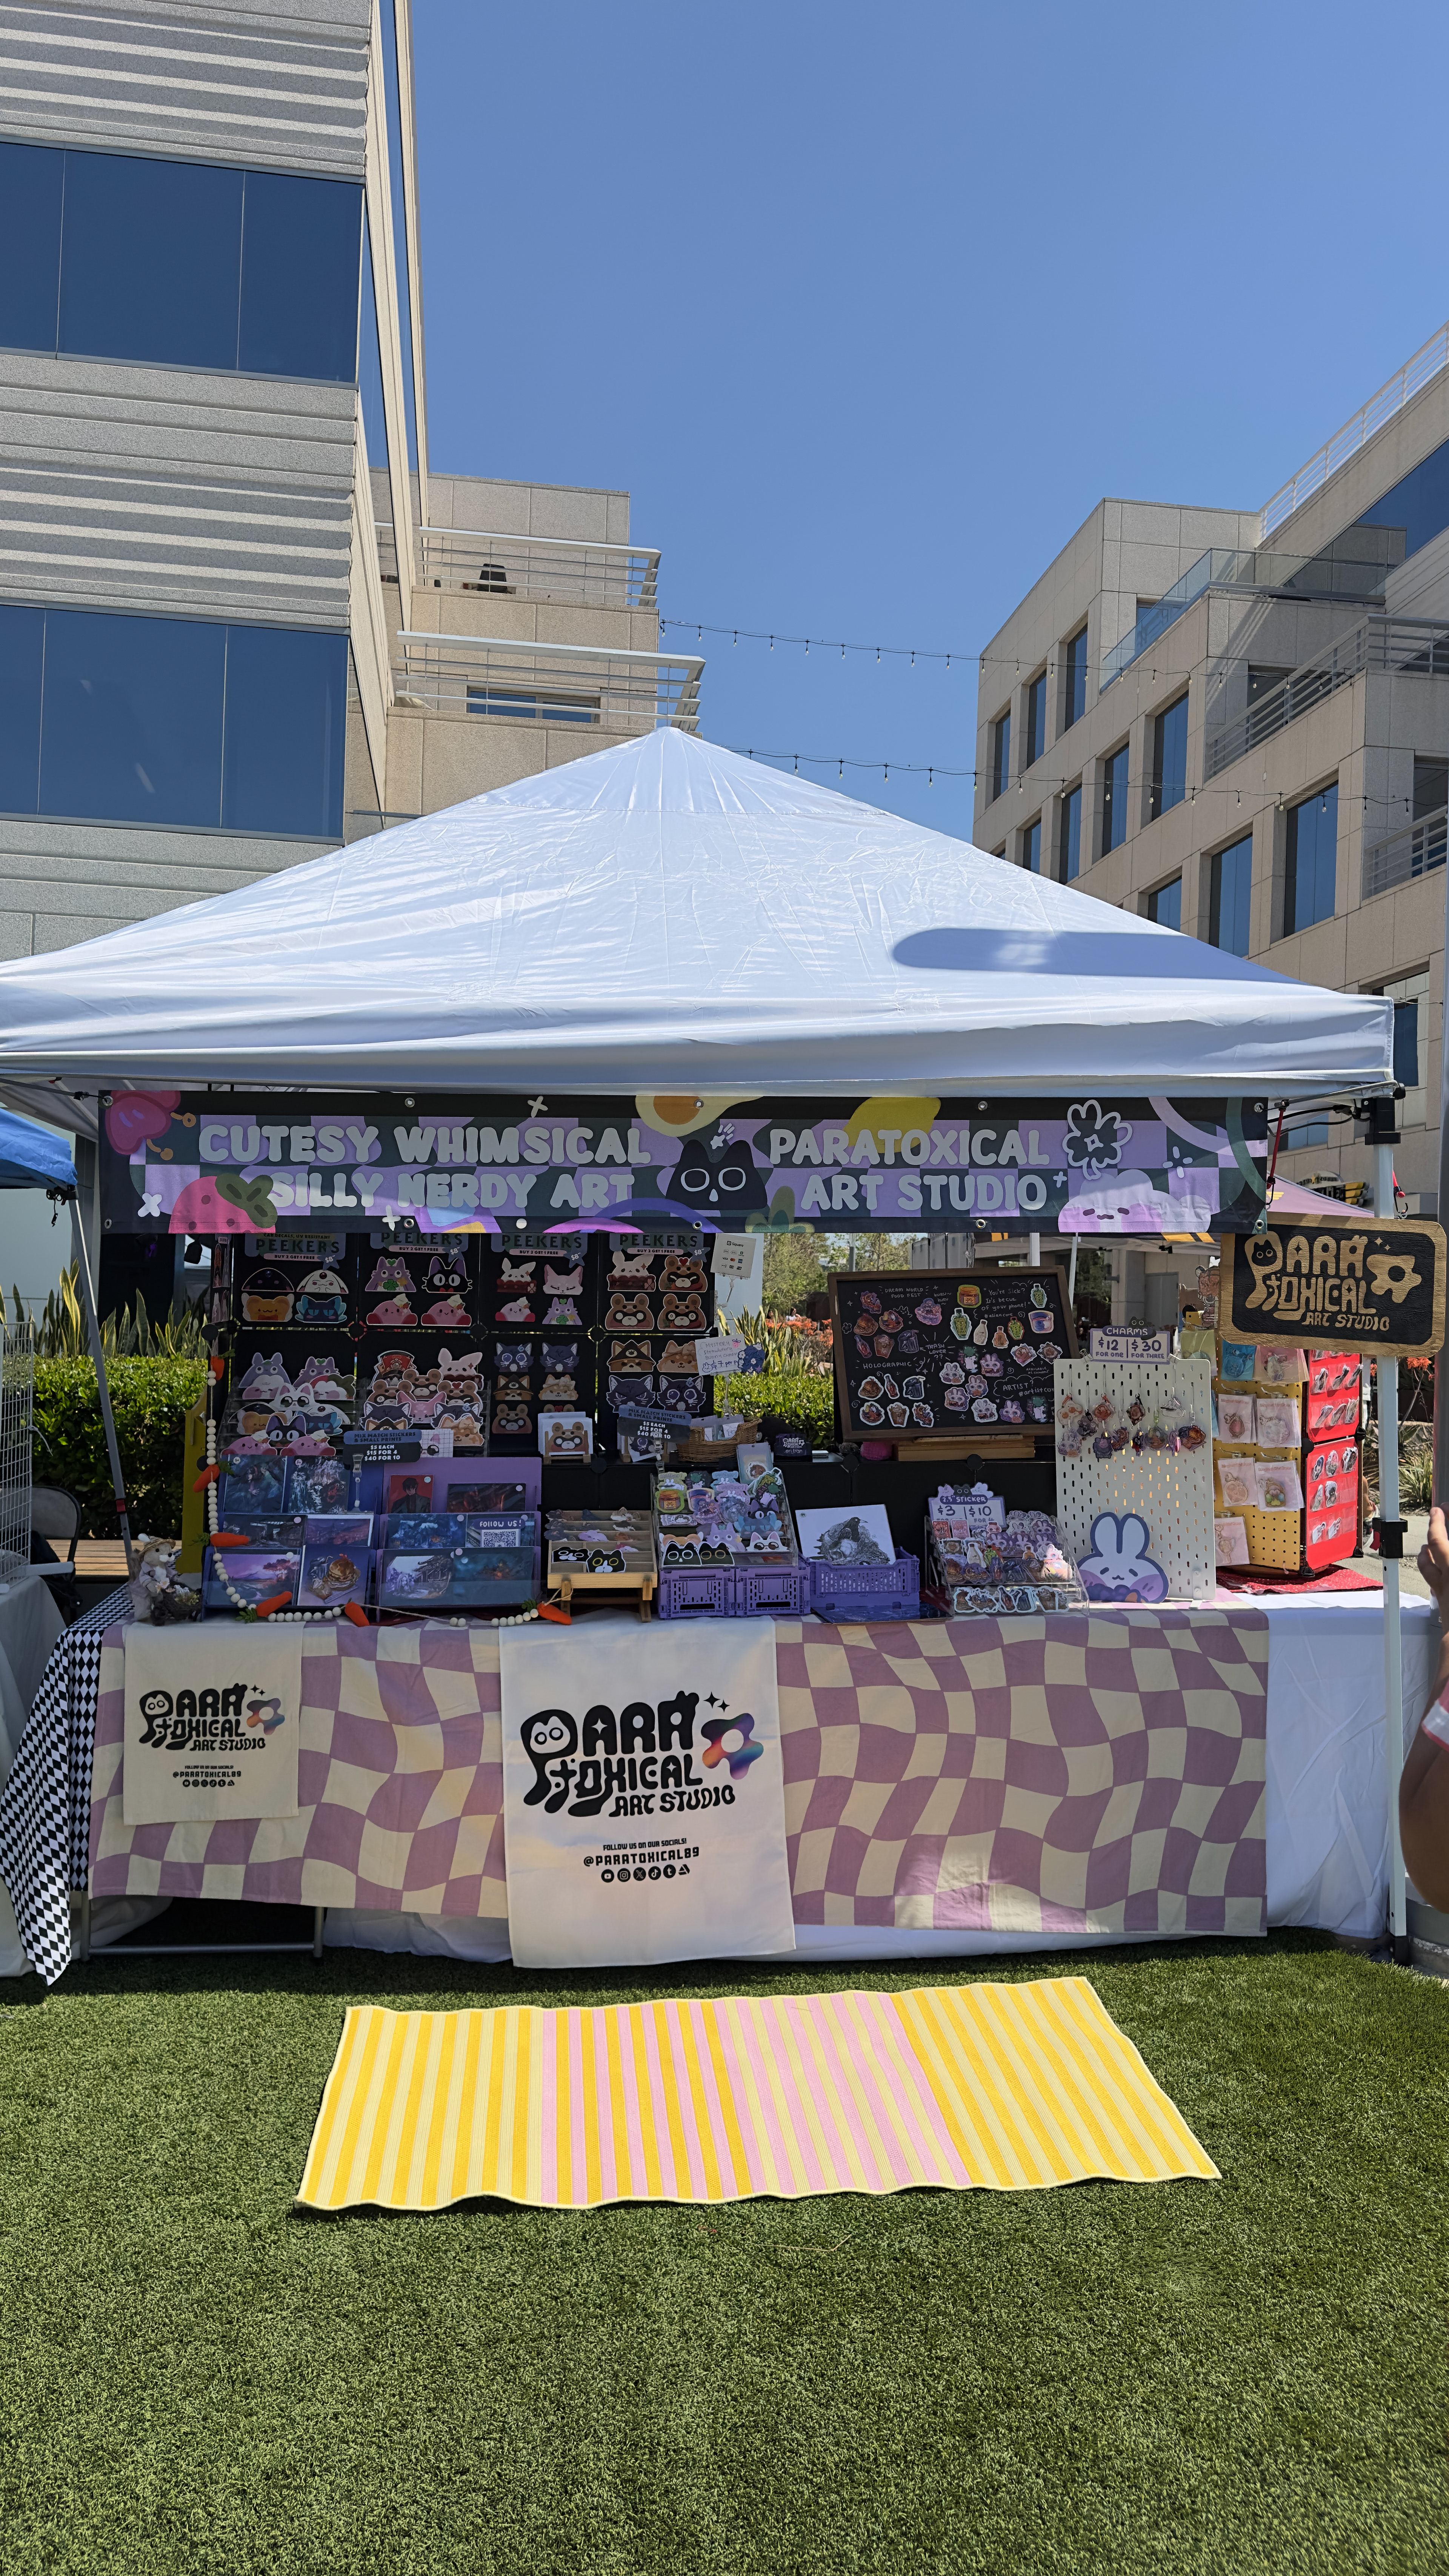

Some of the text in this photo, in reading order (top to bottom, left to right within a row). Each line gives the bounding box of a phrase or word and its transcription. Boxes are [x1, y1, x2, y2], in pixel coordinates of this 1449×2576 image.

[199, 1124, 652, 1164] CUTESY WHIMSICAL
[769, 1129, 1050, 1167] PARATOXICAL
[265, 1172, 635, 1208] SILLY NERDY ART
[801, 1174, 1048, 1211] ART STUDIO
[381, 1233, 462, 1245] PEEKERS
[502, 1235, 581, 1248] PEEKERS
[620, 1234, 697, 1247] PEEKERS
[256, 1239, 339, 1253] PEEKERS
[1302, 1312, 1391, 1331] ART STUDIO
[1106, 1327, 1148, 1336] CHARMS
[1098, 1337, 1118, 1350] $12
[1131, 1339, 1161, 1352] $30
[938, 1505, 955, 1516] $3
[969, 1506, 992, 1517] $10
[189, 1738, 266, 1751] ART STUDIO
[608, 1784, 735, 1817] ART STUDIO
[661, 1838, 687, 1847] SOCIALS!
[583, 1847, 700, 1867] @PARATOXICAL89
